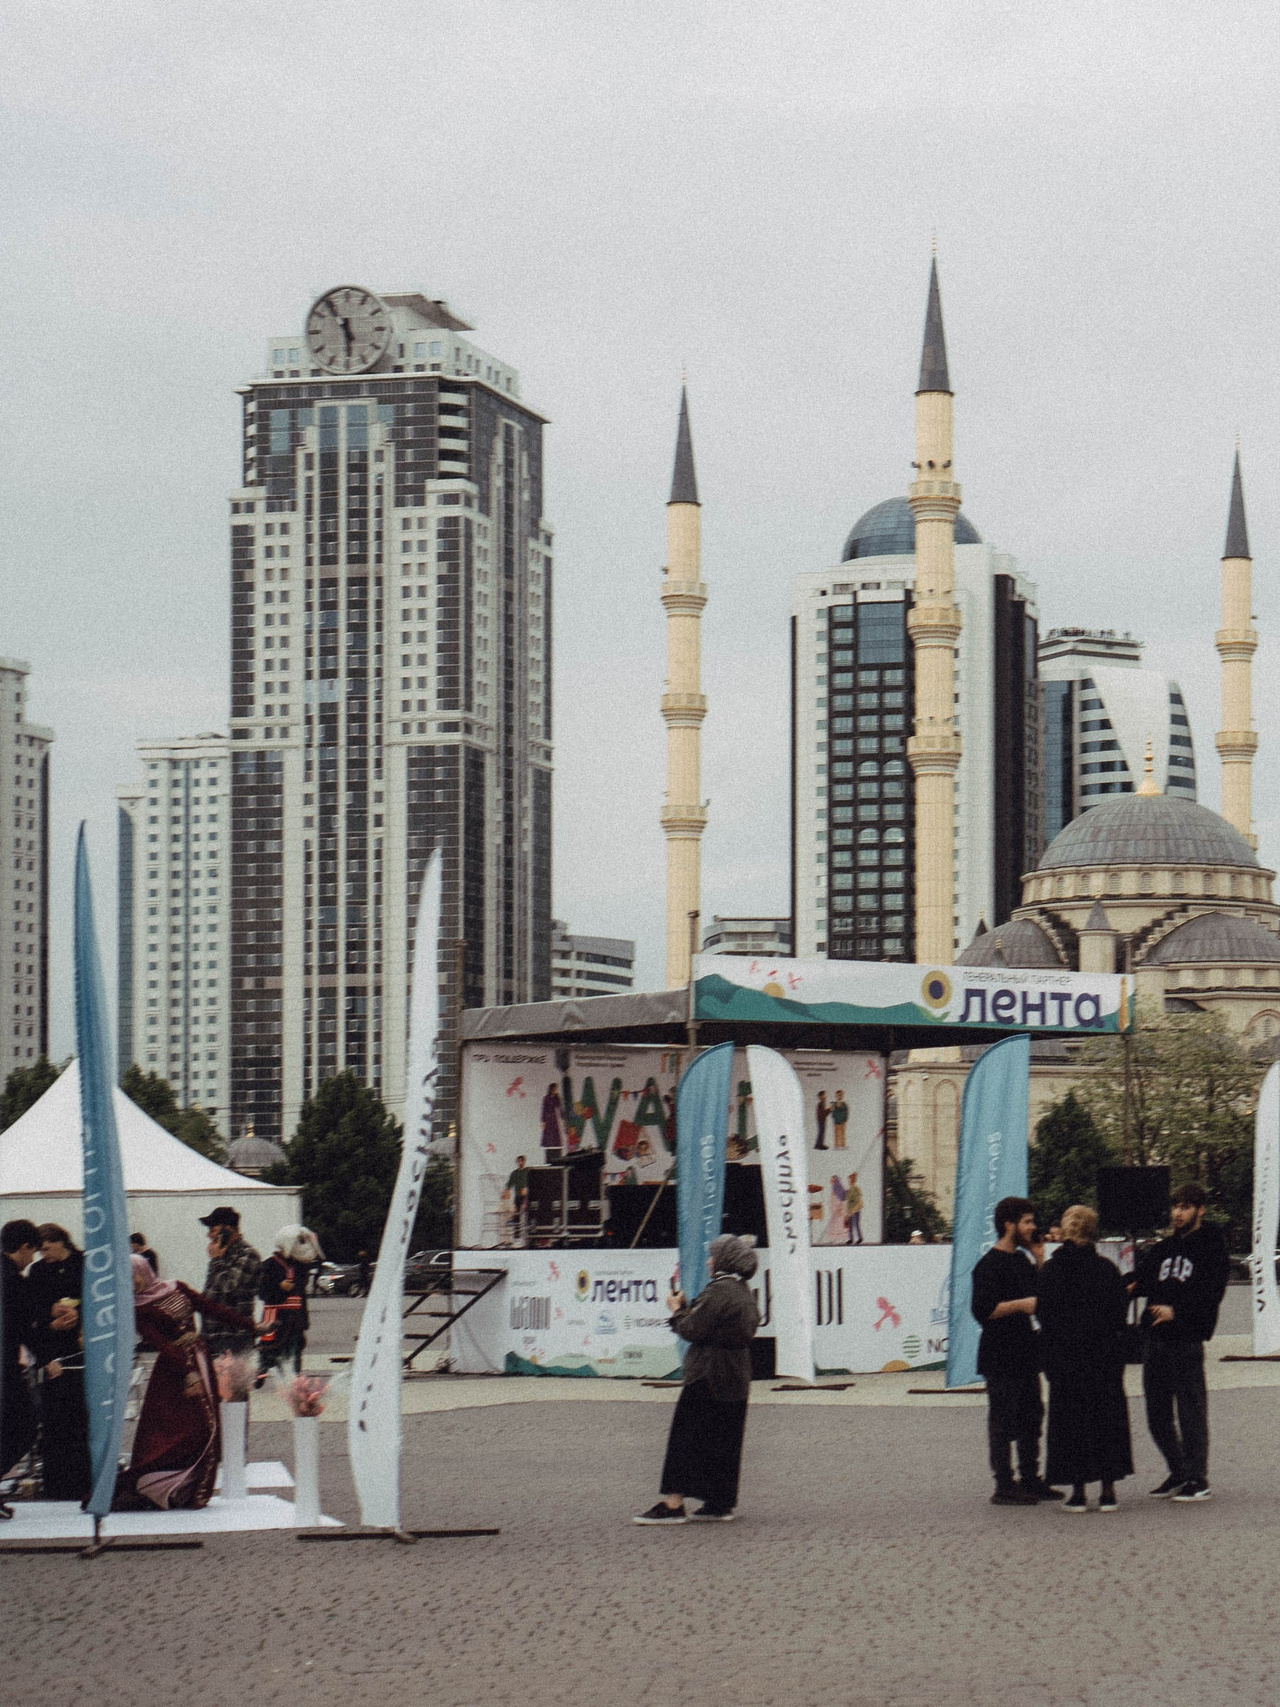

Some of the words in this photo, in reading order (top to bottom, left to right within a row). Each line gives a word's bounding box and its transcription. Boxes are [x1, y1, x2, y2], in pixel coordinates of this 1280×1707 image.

[959, 988, 1106, 1028] лента
[1158, 1255, 1194, 1281] GAP
[83, 1242, 117, 1343] land
[591, 1279, 659, 1303] лента
